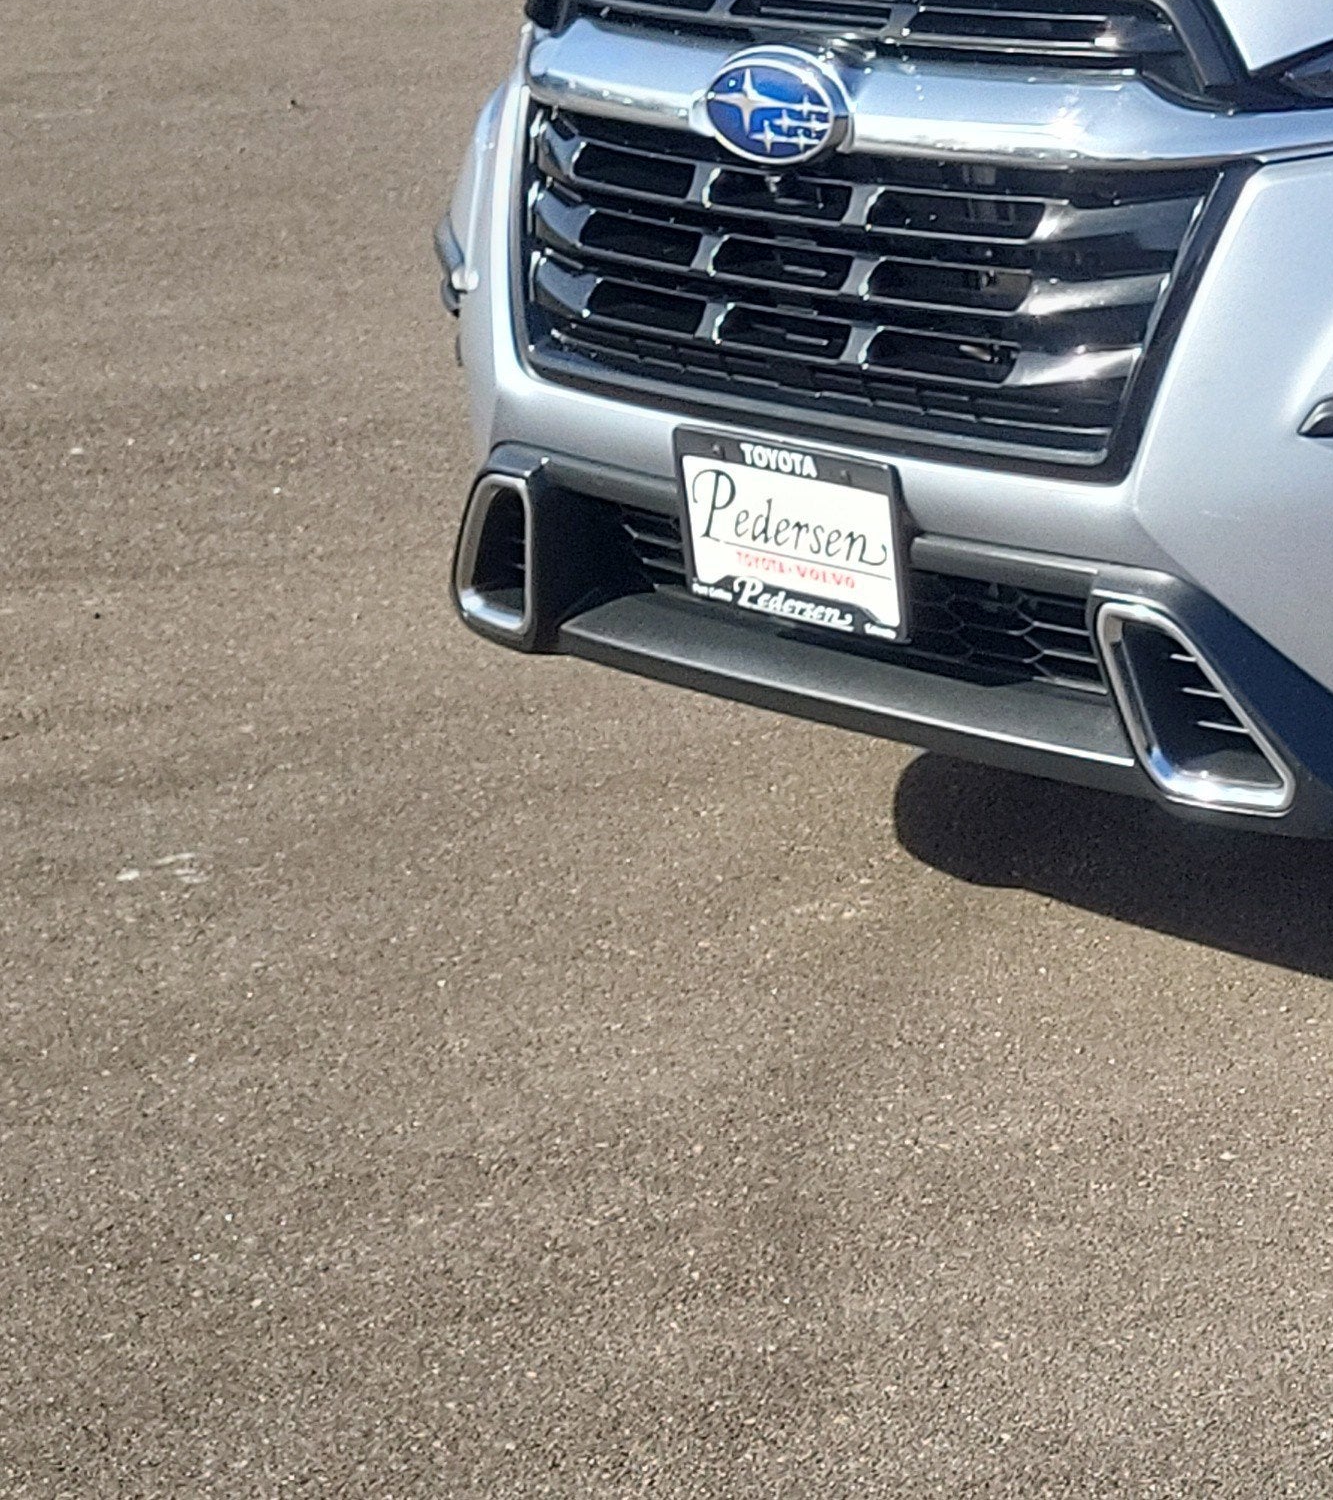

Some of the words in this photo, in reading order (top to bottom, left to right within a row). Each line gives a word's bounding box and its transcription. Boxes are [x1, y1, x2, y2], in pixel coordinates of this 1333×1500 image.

[740, 442, 818, 479] TOYOTA
[692, 468, 888, 567] Pedersen
[796, 562, 856, 590] VOLVO
[733, 576, 854, 632] Pedersen
